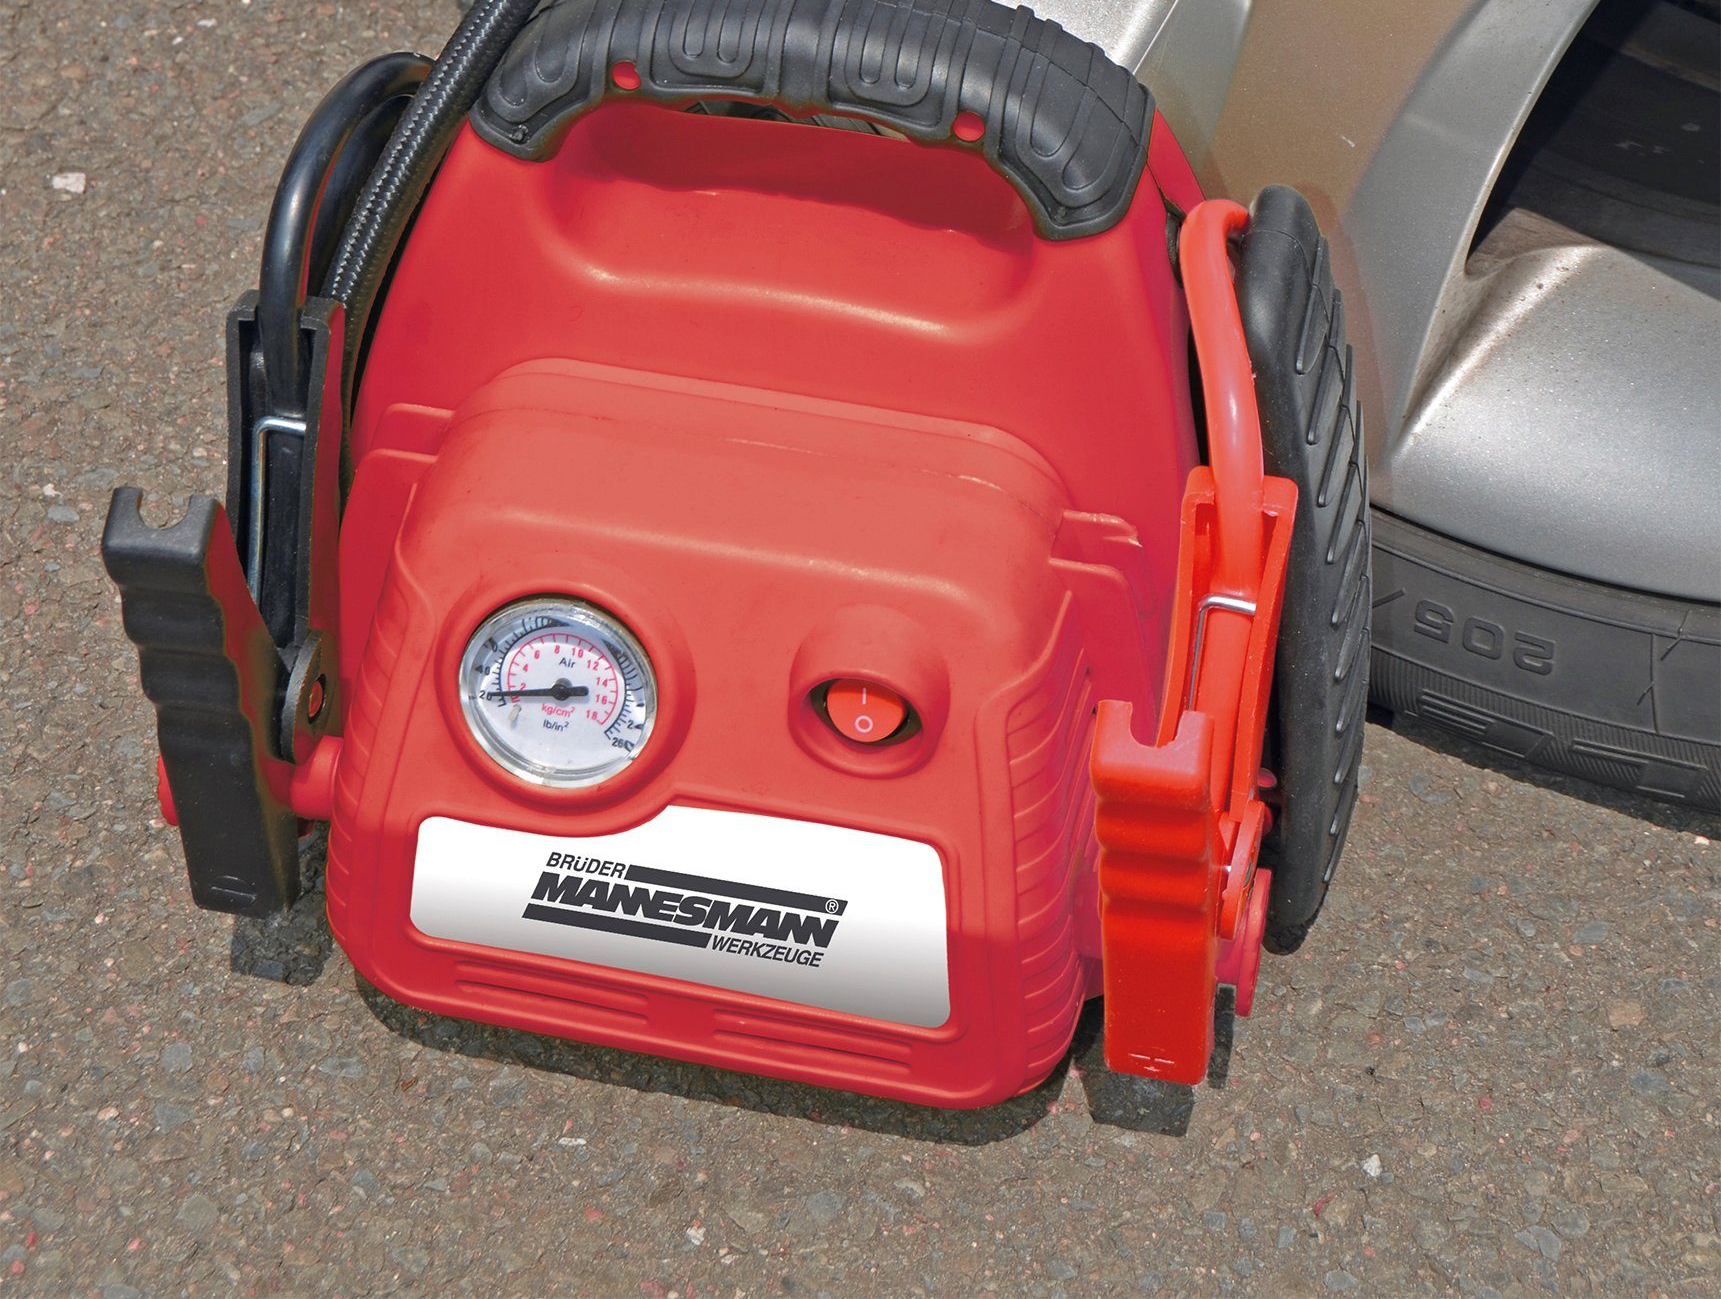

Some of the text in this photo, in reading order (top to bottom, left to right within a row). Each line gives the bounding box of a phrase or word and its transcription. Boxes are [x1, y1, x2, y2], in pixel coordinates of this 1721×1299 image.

[1413, 599, 1556, 676] 205
[534, 650, 540, 659] 6
[554, 645, 560, 654] 8
[571, 648, 584, 658] 10
[523, 664, 529, 672] 4
[558, 657, 575, 669] Air
[587, 660, 599, 670] 12
[596, 677, 608, 687] 14
[595, 695, 608, 705] 16
[586, 710, 598, 720] 18
[546, 851, 626, 879] BRÜDER
[530, 870, 840, 949] MANNESMANN
[711, 935, 824, 969] WERKZEUGE
